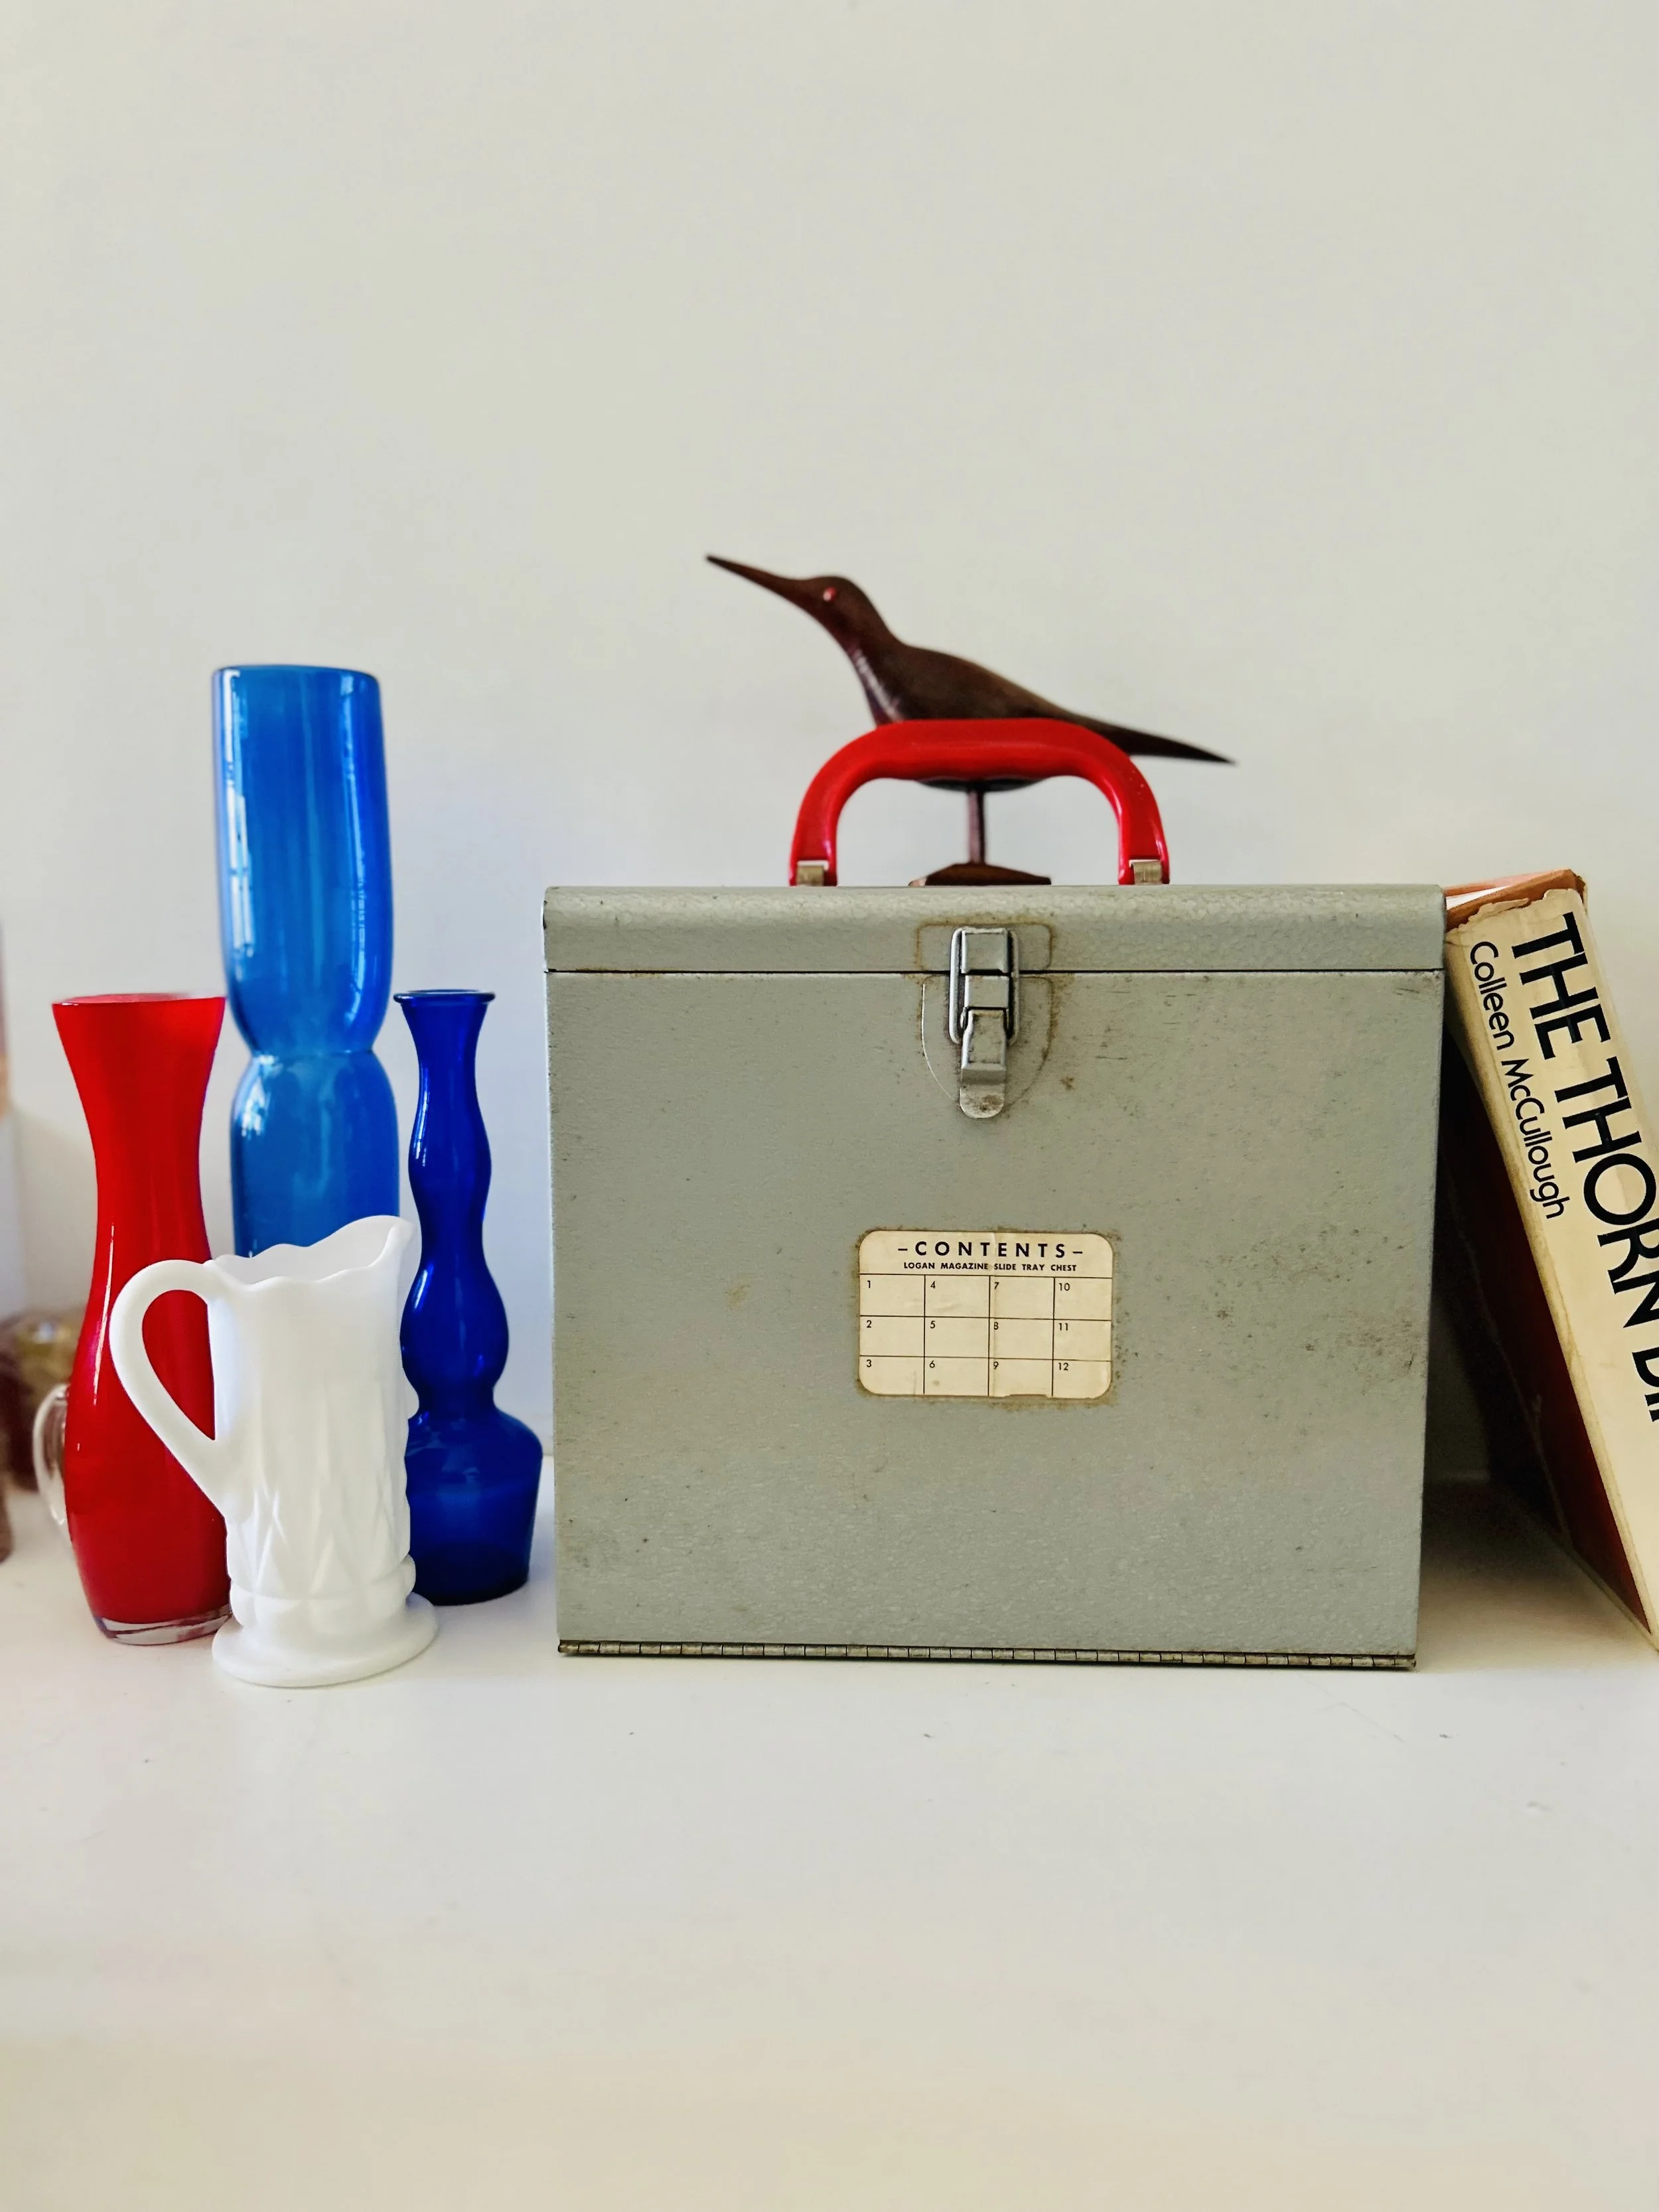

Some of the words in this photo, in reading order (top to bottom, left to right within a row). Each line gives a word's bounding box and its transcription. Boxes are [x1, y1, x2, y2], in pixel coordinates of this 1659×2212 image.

[1511, 911, 1611, 1061] THE
[1469, 941, 1516, 1051] Colleen
[1500, 1058, 1570, 1219] McCullough
[1554, 1056, 1659, 1328] THORN
[940, 1262, 989, 1270] MAGAZINE
[867, 1280, 871, 1289] 1
[994, 1282, 999, 1290] 7
[1059, 1282, 1070, 1291] 10
[866, 1319, 872, 1329] 2
[930, 1320, 936, 1329] 5
[993, 1321, 999, 1331] 8
[1058, 1322, 1069, 1331] 11
[866, 1359, 872, 1368] 3
[929, 1360, 936, 1368] 6
[993, 1361, 999, 1370] 9
[1058, 1362, 1069, 1371] 12
